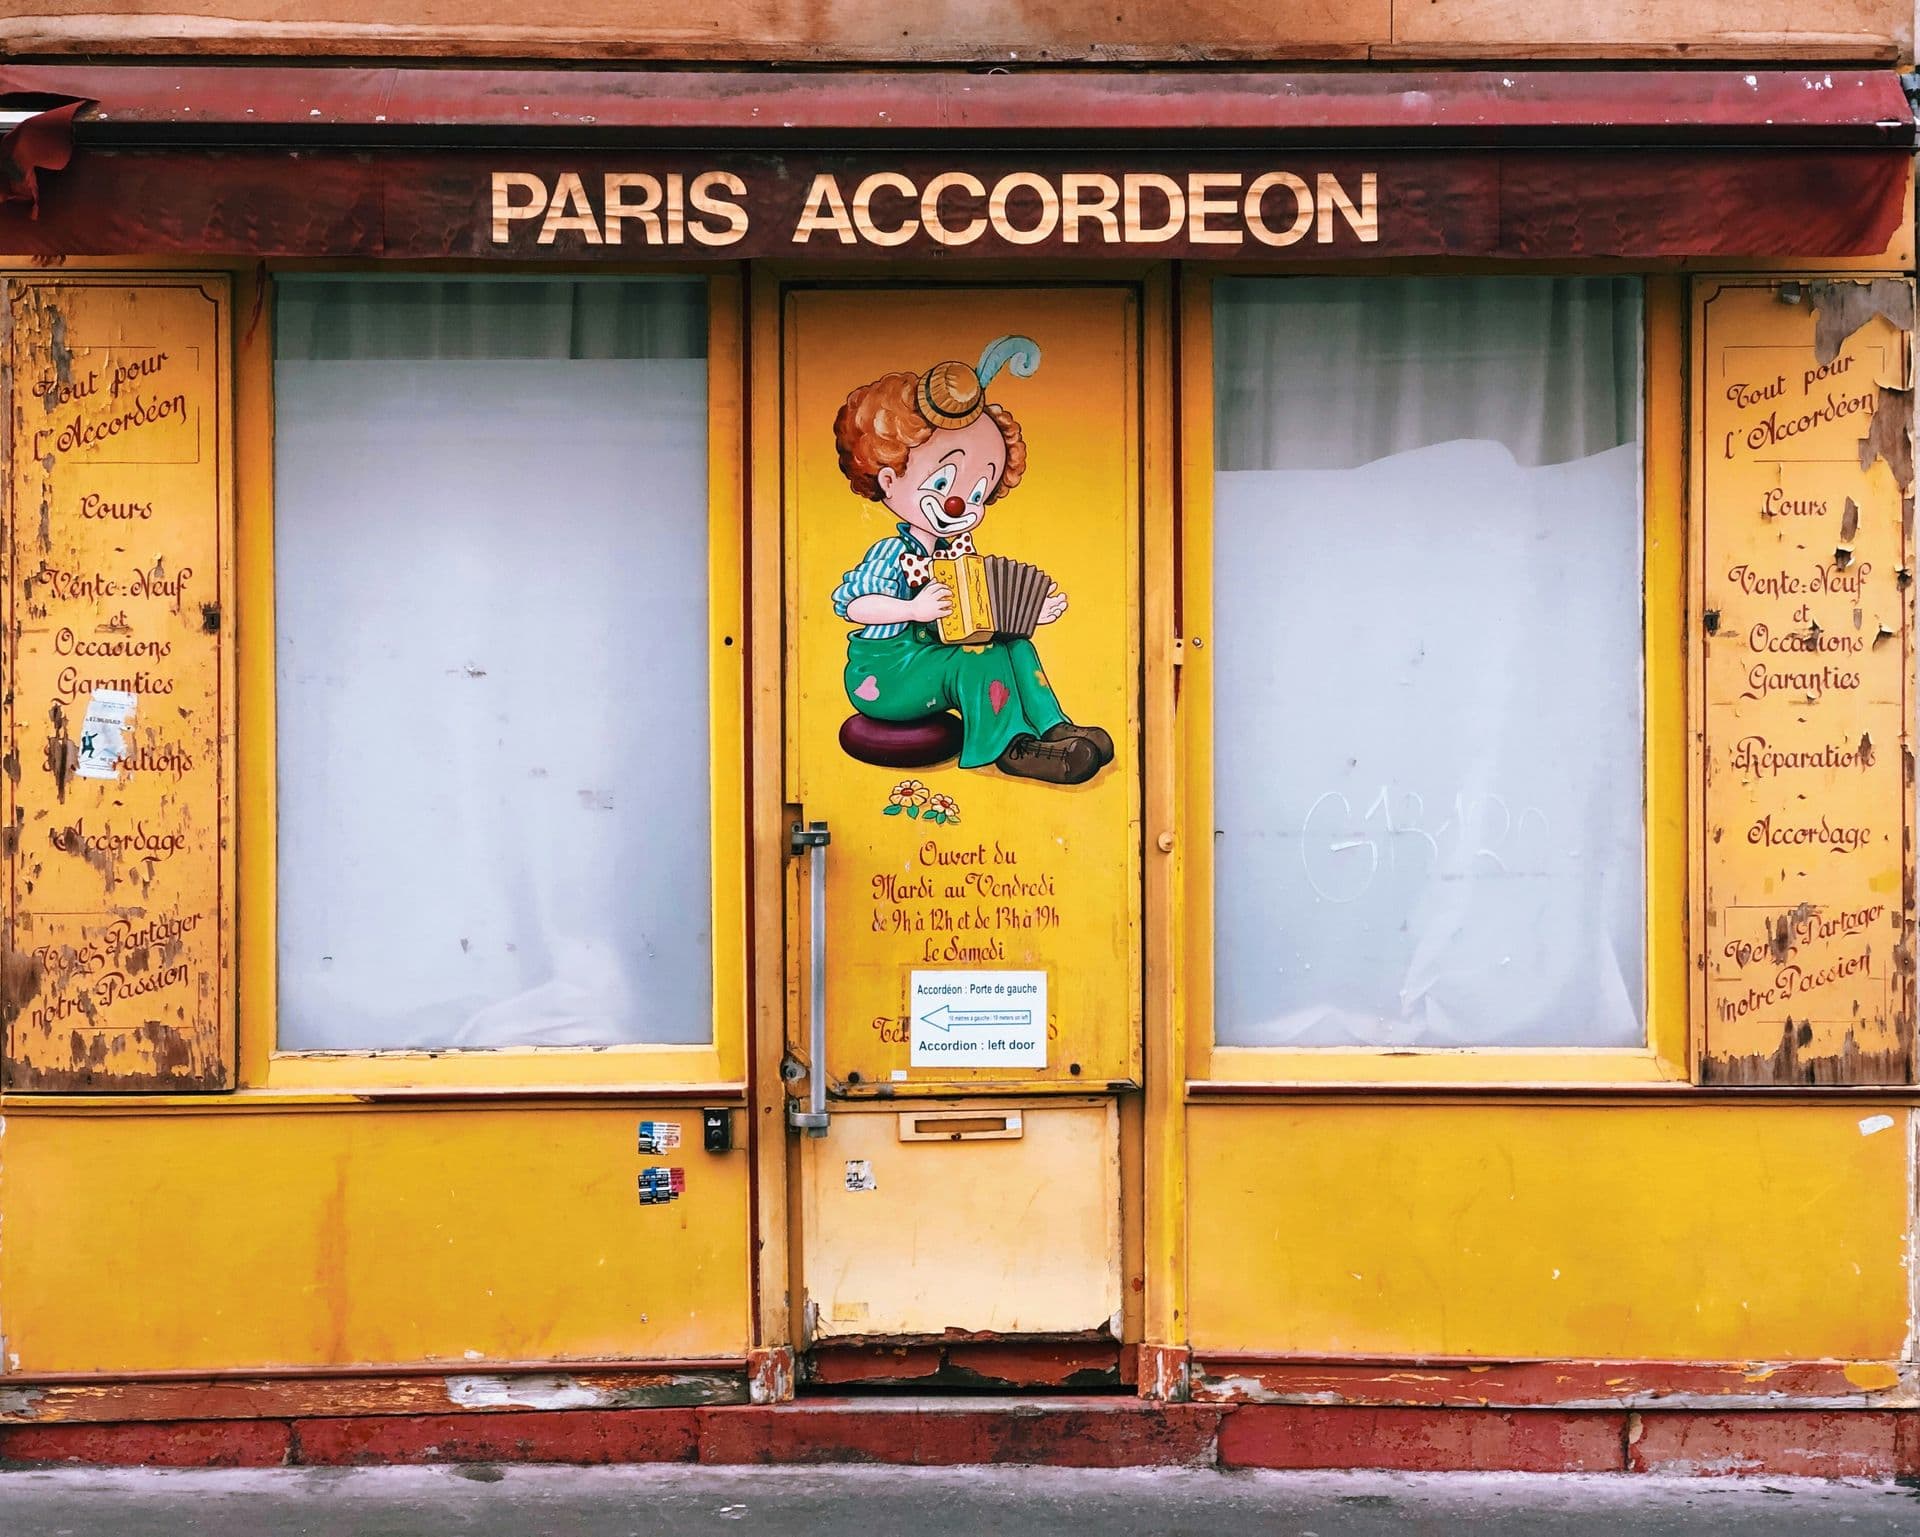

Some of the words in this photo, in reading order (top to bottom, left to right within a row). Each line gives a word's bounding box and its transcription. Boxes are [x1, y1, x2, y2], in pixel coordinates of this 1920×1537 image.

[490, 172, 748, 246] PARIS
[792, 172, 1379, 247] ACCORDEON
[32, 370, 98, 405] Tout
[110, 351, 168, 396] pour
[1727, 375, 1786, 409] Tout
[1804, 355, 1855, 394] pour
[80, 493, 153, 520] Cours
[1763, 488, 1828, 517] Cours
[109, 610, 128, 628] et
[1793, 604, 1811, 624] et
[55, 627, 171, 667] Occasions
[1750, 623, 1863, 658] Occasions
[51, 666, 174, 705] Garanties
[1740, 663, 1860, 701] Garanties
[1735, 736, 1876, 778] Réparations
[50, 818, 186, 862] Accordage
[919, 840, 987, 866] Ouvert
[993, 840, 1017, 865] du
[1747, 815, 1871, 853] Accordage
[872, 873, 934, 904] Mardi
[944, 885, 966, 899] au
[965, 872, 1055, 899] Vendredi
[104, 913, 203, 954] Partager
[872, 908, 887, 932] de
[892, 908, 911, 935] 9h
[915, 911, 925, 931] à
[929, 908, 953, 932] 12h
[957, 910, 970, 930] et
[974, 905, 990, 930] de
[996, 905, 1020, 932] 13h
[1022, 909, 1032, 929] à
[1035, 905, 1060, 934] 19h
[1796, 904, 1885, 945] Partager
[922, 936, 940, 962] Le
[943, 935, 1006, 963] Samedi
[32, 994, 86, 1031] notre
[95, 964, 188, 1006] Passion
[917, 984, 963, 995] Accordéon
[969, 983, 993, 994] Porte
[994, 983, 1005, 994] de
[1006, 983, 1038, 997] gauche
[1726, 988, 1775, 1023] notre
[1775, 954, 1871, 1000] Passion
[919, 1040, 977, 1051] Accordion
[988, 1039, 1006, 1051] left
[1008, 1039, 1036, 1050] door
